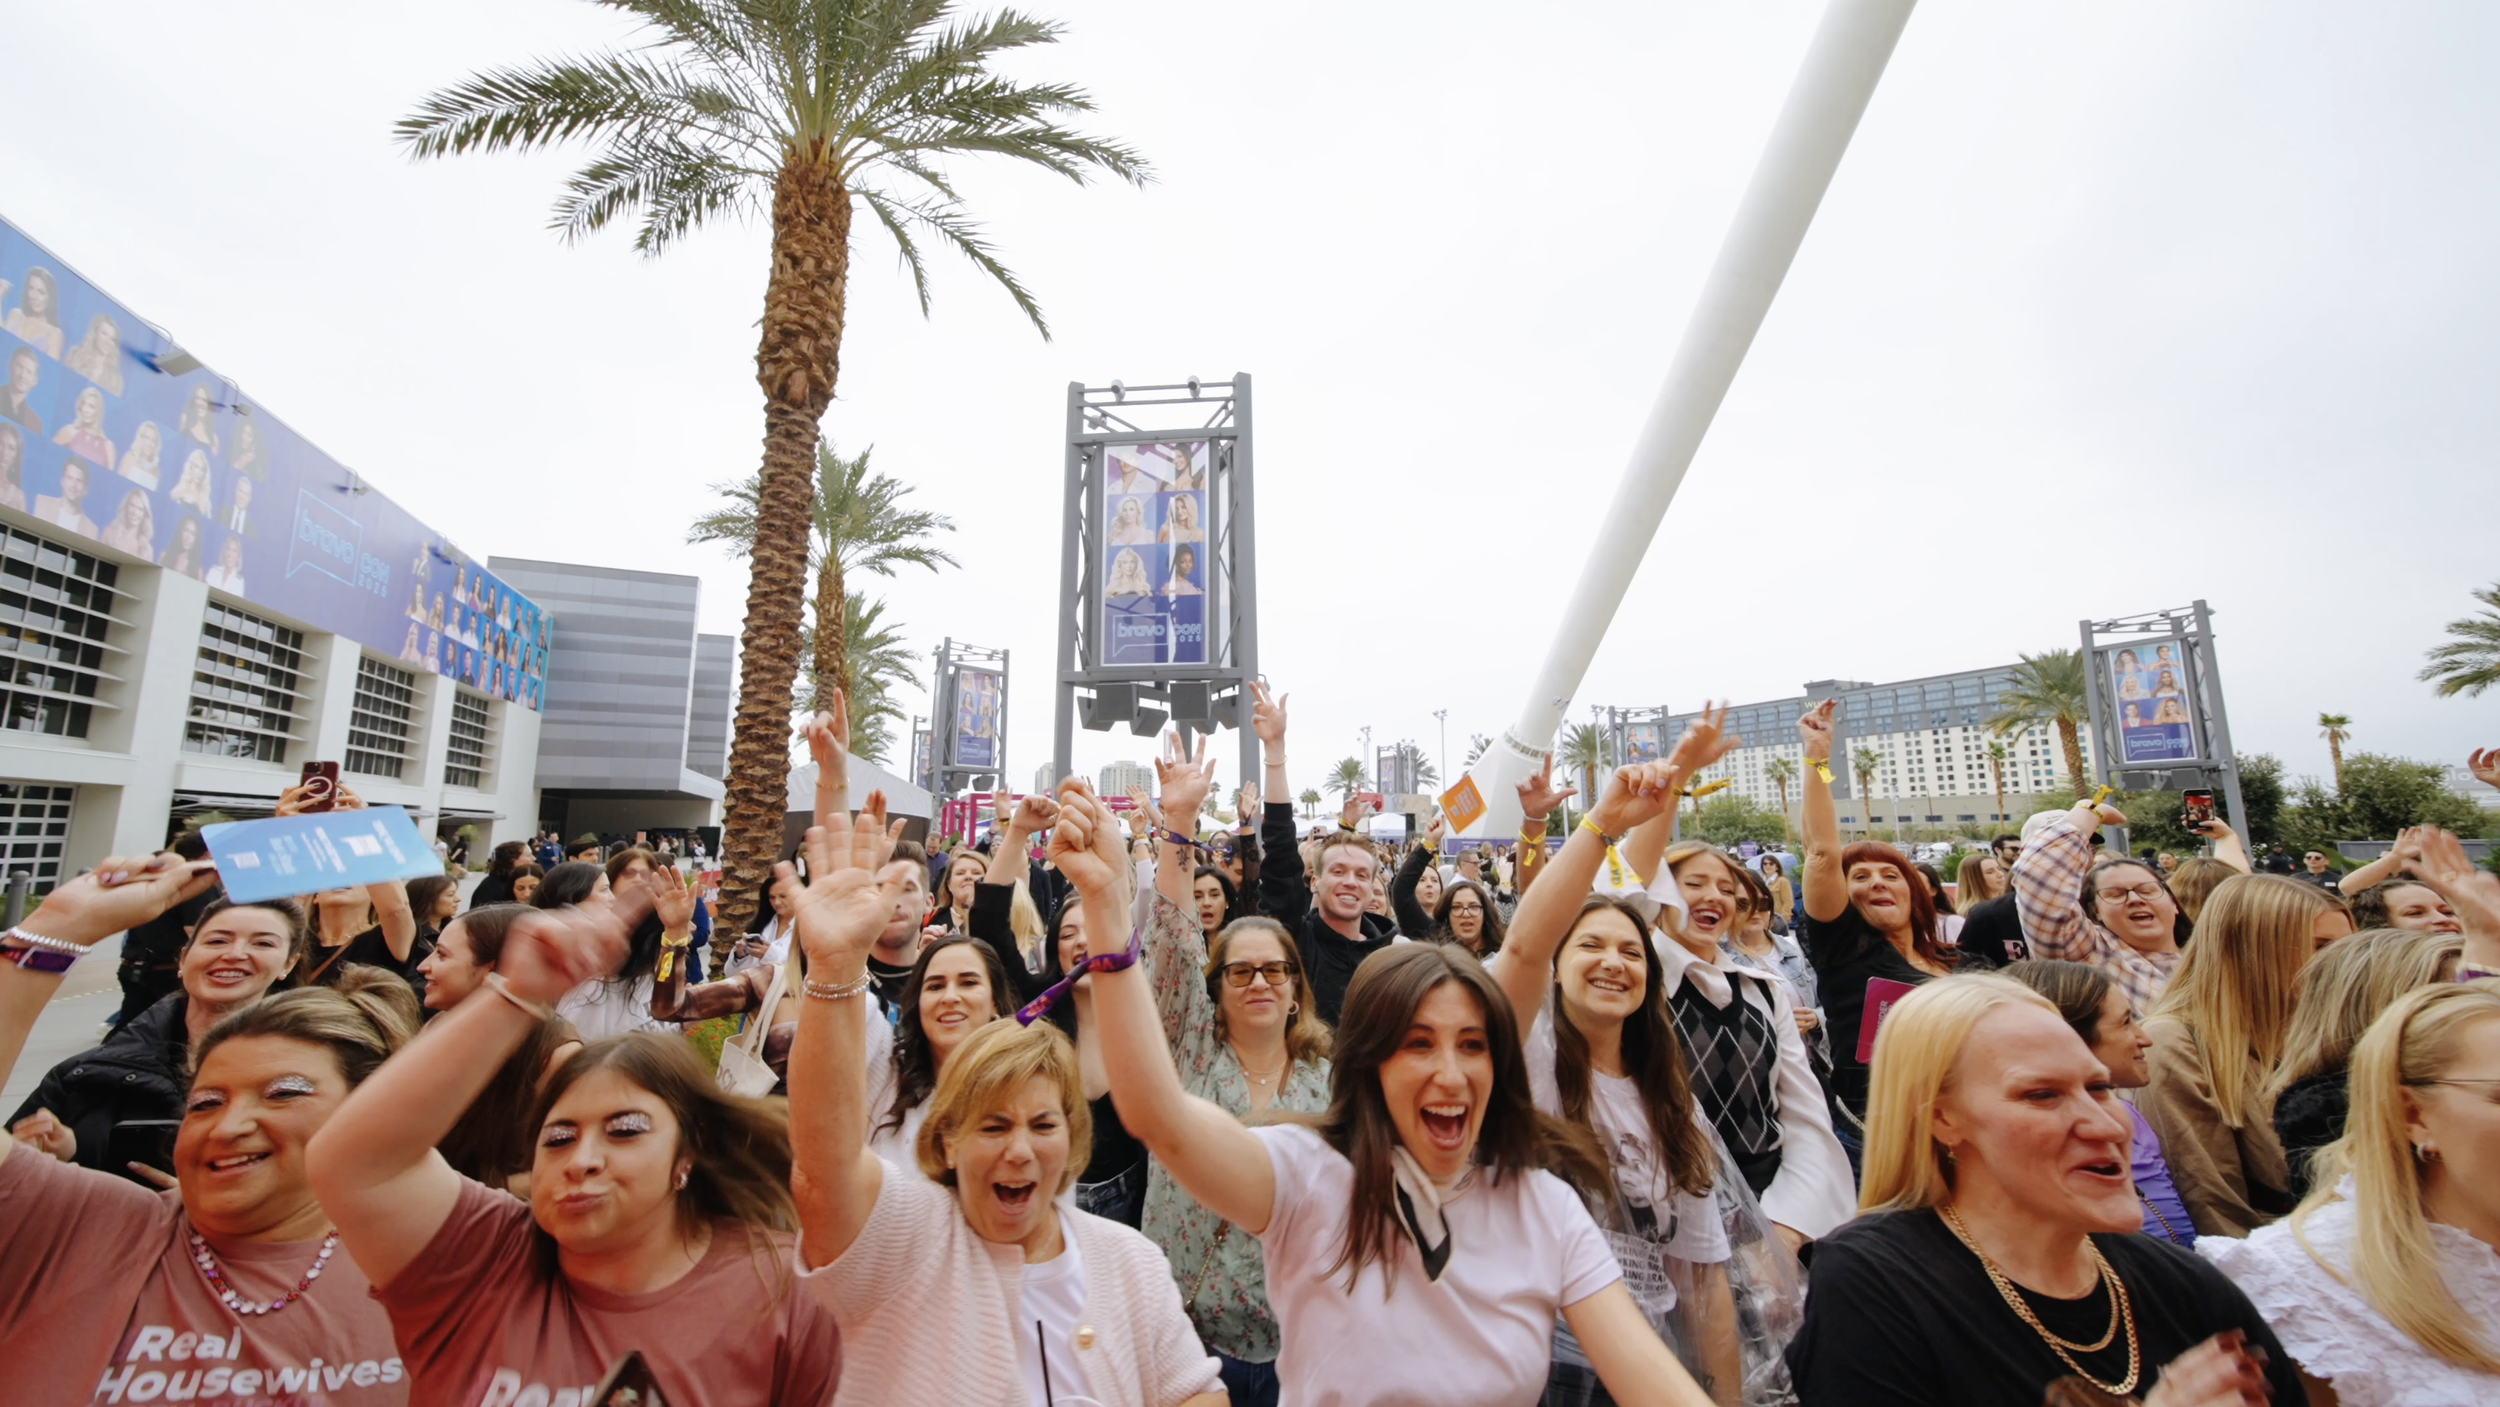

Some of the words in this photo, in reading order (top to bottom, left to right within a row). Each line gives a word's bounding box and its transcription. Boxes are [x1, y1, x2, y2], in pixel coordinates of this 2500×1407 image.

[300, 508, 355, 565] bravo
[1117, 622, 1166, 638] bravo
[2130, 739, 2163, 748] bravo
[126, 1325, 242, 1362] Real
[94, 1357, 404, 1404] Housewives
